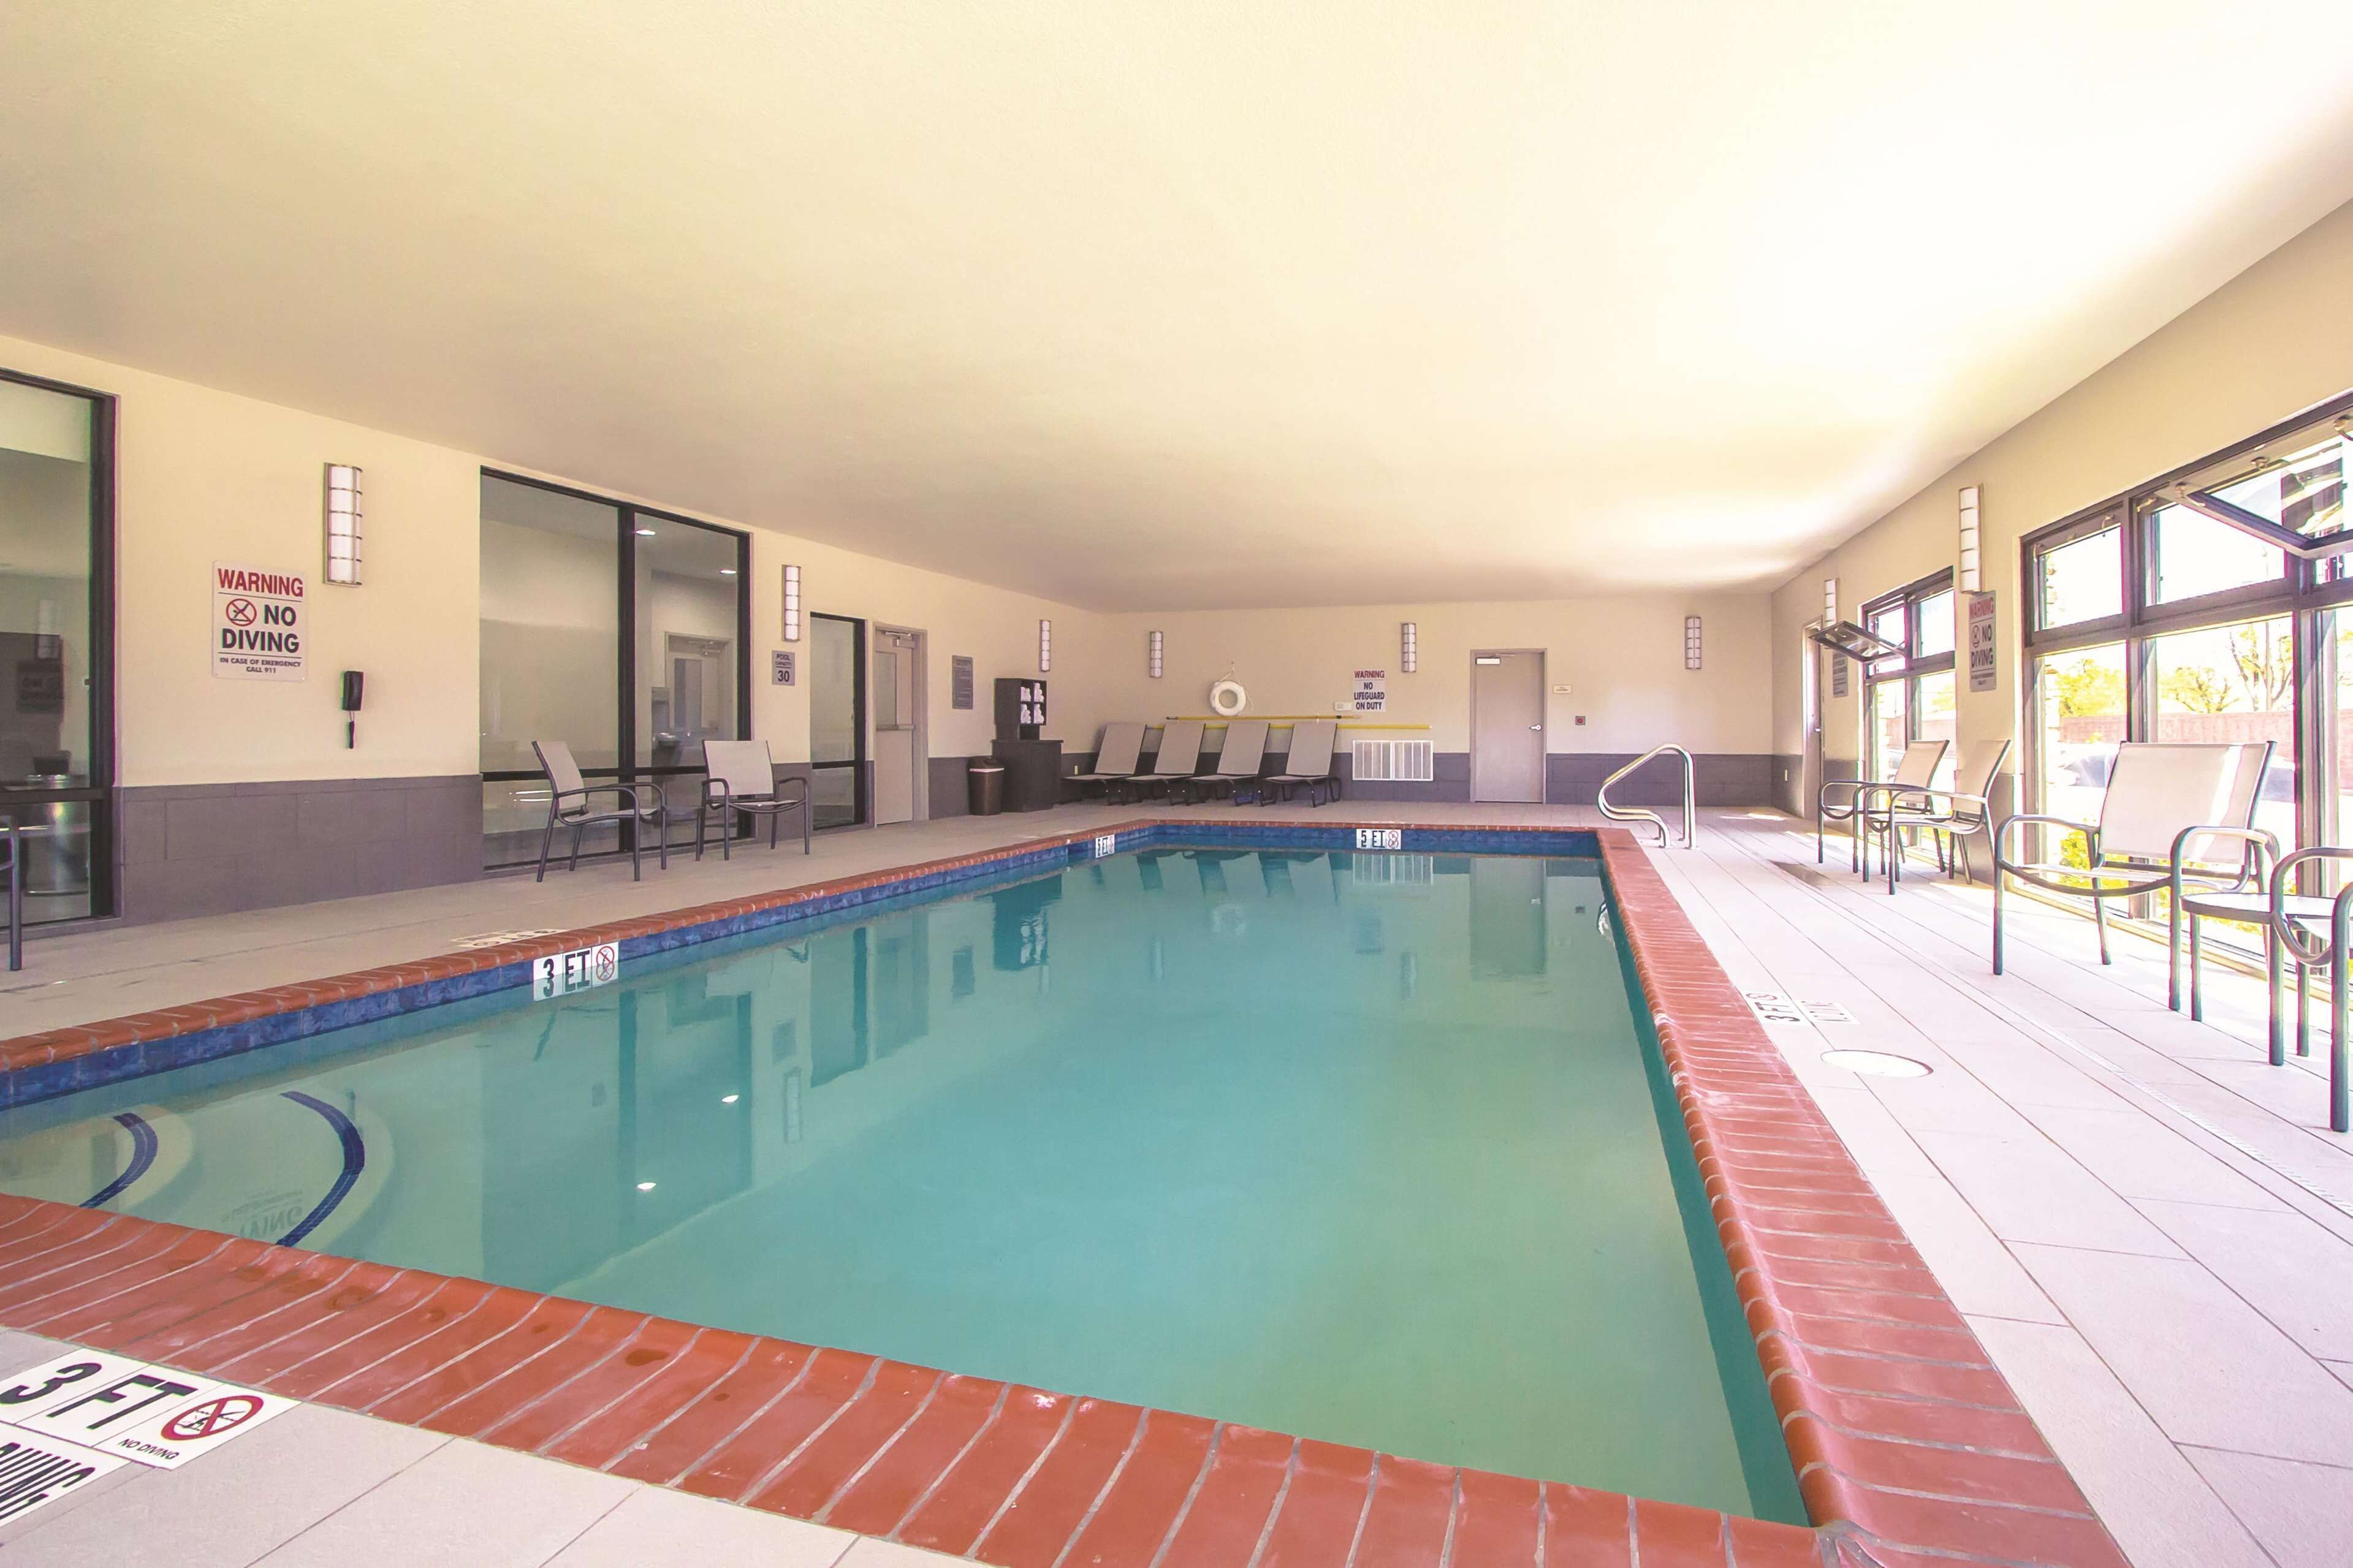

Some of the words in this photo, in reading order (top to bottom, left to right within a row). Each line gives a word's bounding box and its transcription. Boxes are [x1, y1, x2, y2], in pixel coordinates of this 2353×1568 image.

[218, 569, 303, 597] WARNING
[264, 604, 297, 626] NO
[1969, 597, 1994, 619] WARNING
[221, 628, 300, 653] DIVING
[1982, 624, 1993, 643] NO
[261, 659, 302, 668] EMERGENCY
[1971, 647, 1994, 668] DIVING
[777, 670, 790, 683] 30
[1356, 702, 1365, 710] ON
[1366, 702, 1382, 710] DUTY
[0, 1362, 102, 1404] 3
[46, 1374, 199, 1430] FT
[117, 1438, 141, 1449] NO
[136, 1444, 180, 1460] DIVING
